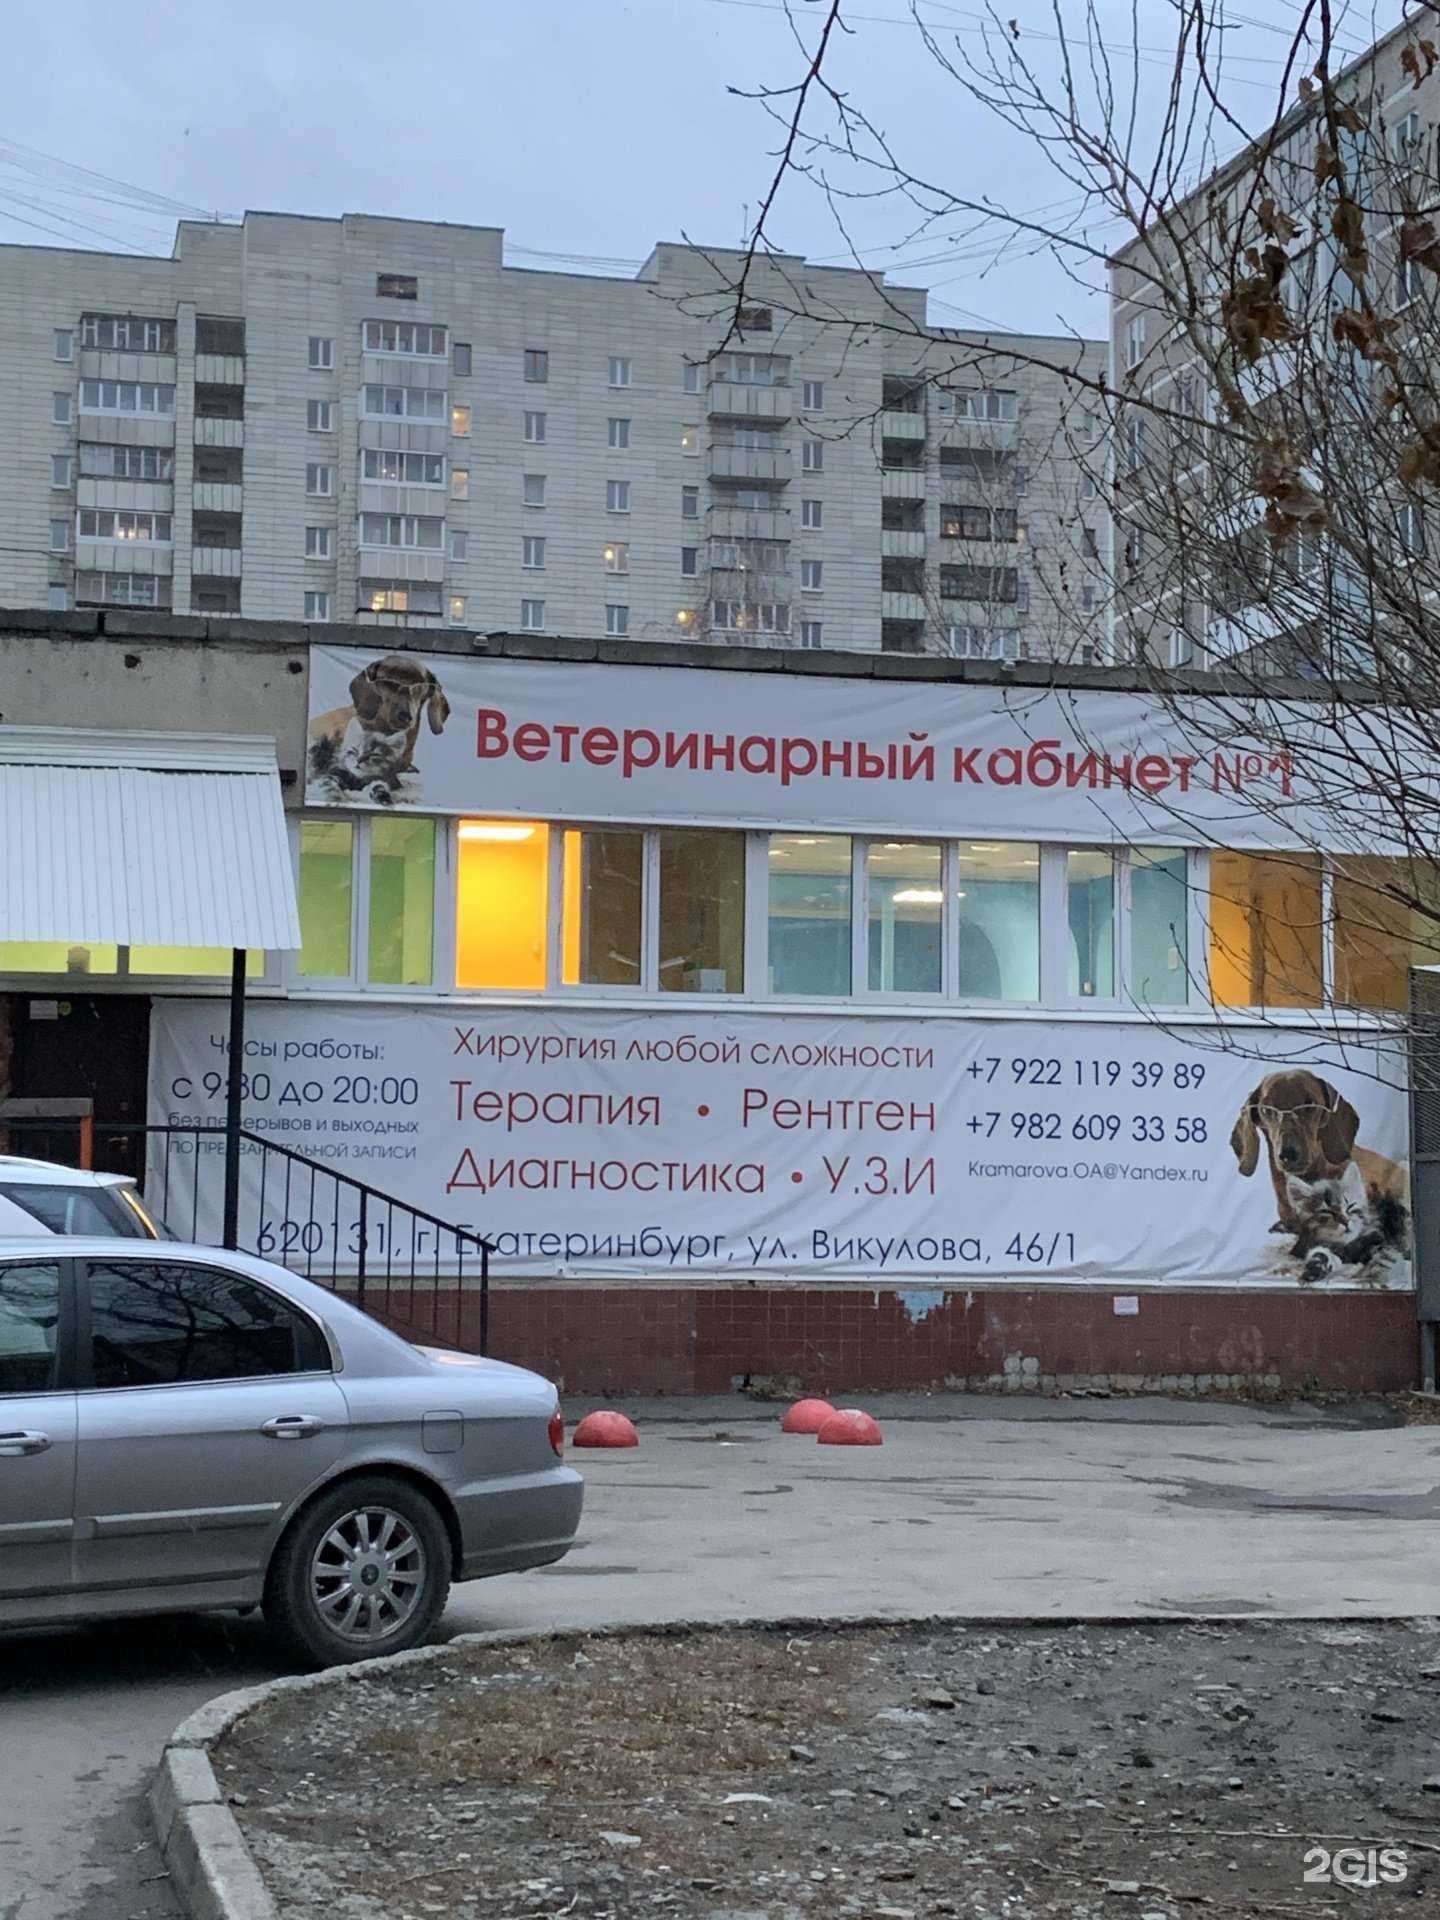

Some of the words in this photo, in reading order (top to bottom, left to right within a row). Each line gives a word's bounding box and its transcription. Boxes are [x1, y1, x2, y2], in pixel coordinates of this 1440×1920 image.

[477, 708, 935, 786] Ветеринарный
[953, 740, 1199, 794] кабинет
[210, 1034, 277, 1057] Чсы
[284, 1037, 385, 1062] работы:
[453, 1026, 616, 1064] Хирургия
[625, 1035, 740, 1064] любой
[750, 1043, 934, 1068] сложности
[966, 1058, 1001, 1084] +7
[1011, 1059, 1062, 1085] 922
[1075, 1061, 1121, 1087] 119
[1132, 1062, 1164, 1088] 39
[1173, 1063, 1206, 1089] 89
[172, 1078, 192, 1099] с
[278, 1081, 323, 1106] до
[333, 1076, 418, 1105] 20:00
[449, 1080, 660, 1132] Терапия
[742, 1087, 935, 1131] Рентген
[168, 1111, 201, 1128] без
[206, 1115, 312, 1132] пеерывов
[316, 1119, 327, 1131] и
[332, 1119, 418, 1135] выходных
[966, 1112, 1001, 1138] +7
[1011, 1113, 1062, 1139] 982
[1072, 1114, 1121, 1141] 609
[1132, 1116, 1165, 1142] 33
[1174, 1117, 1208, 1143] 58
[352, 1145, 417, 1159] ЗАПИСИ
[446, 1148, 765, 1195] Диагностика
[822, 1155, 935, 1195] У.З.И
[968, 1160, 1208, 1182] Kramarova.OA@Yandex.ru
[456, 1224, 734, 1264] Екатеринбург,
[748, 1235, 797, 1266] ул.
[813, 1229, 991, 1267] Викулова,
[1005, 1232, 1076, 1266] 46/1
